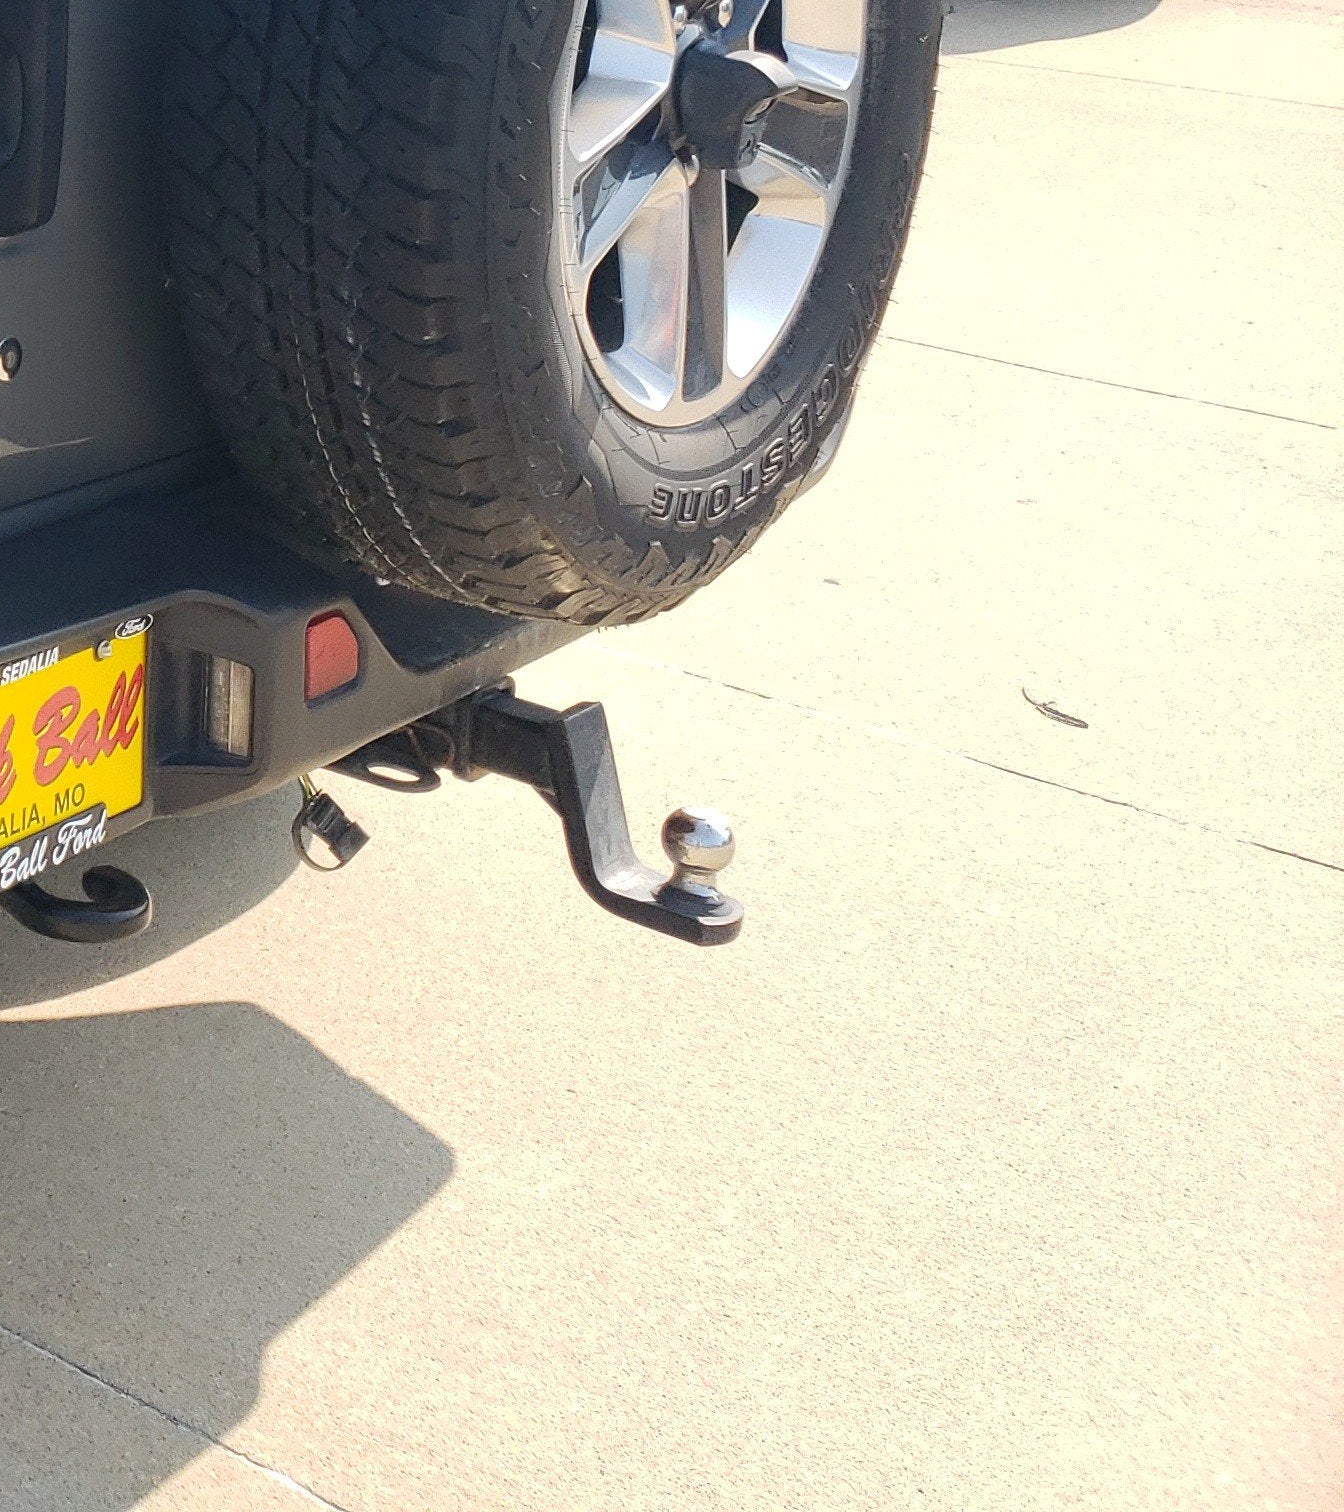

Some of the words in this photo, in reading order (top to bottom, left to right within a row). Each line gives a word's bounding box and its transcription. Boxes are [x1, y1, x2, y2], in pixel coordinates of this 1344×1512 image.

[0, 646, 60, 686] SEDALIA
[33, 664, 144, 787] Ball
[54, 782, 86, 816] MO
[0, 835, 47, 886] Ball
[52, 808, 107, 866] Ford
